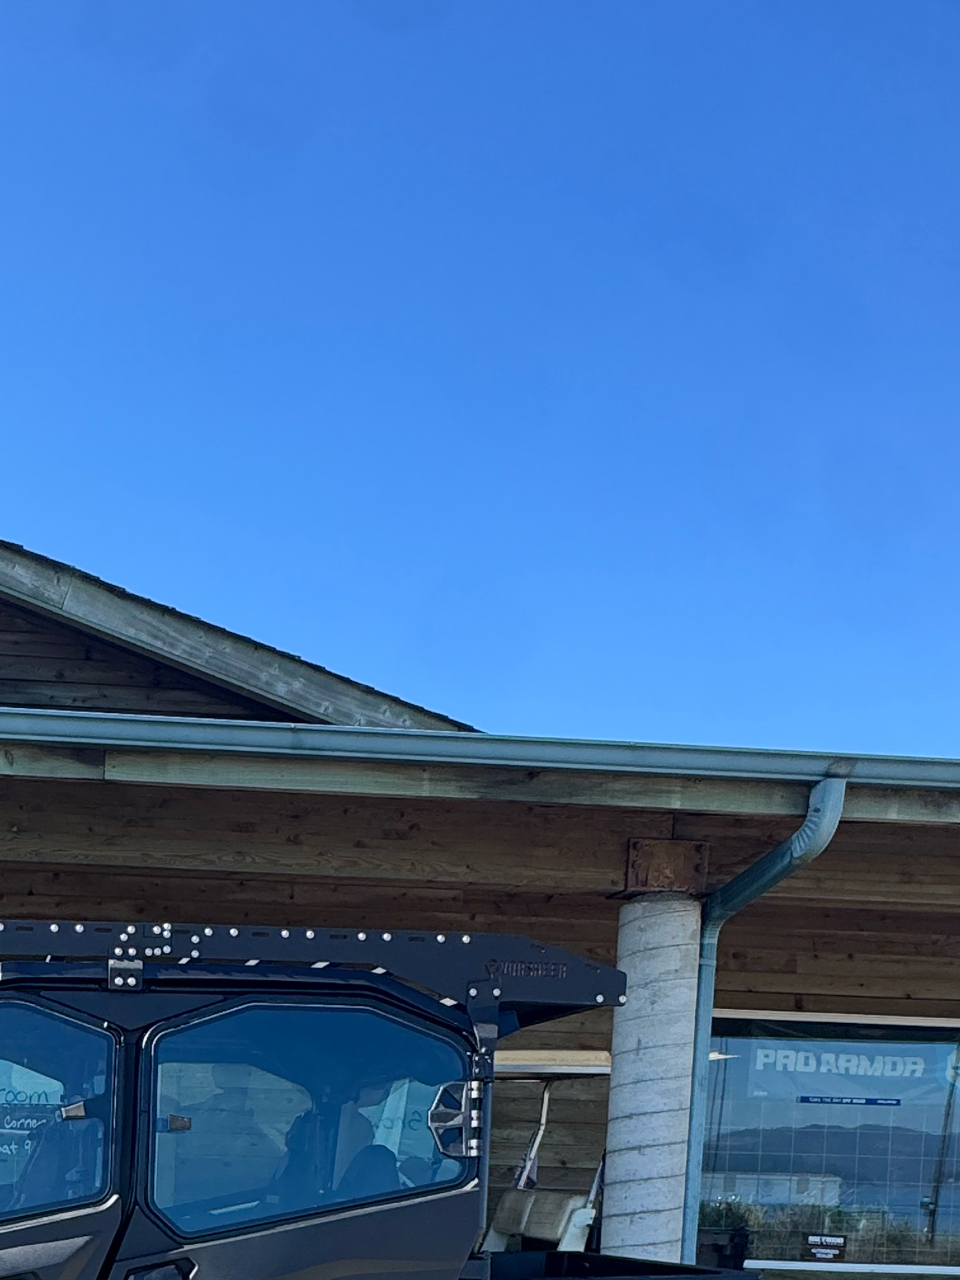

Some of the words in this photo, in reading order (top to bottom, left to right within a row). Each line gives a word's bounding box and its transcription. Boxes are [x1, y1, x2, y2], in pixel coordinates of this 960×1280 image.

[755, 1048, 817, 1073] PRO
[819, 1052, 926, 1077] ARMOR
[3, 1115, 47, 1129] Corner
